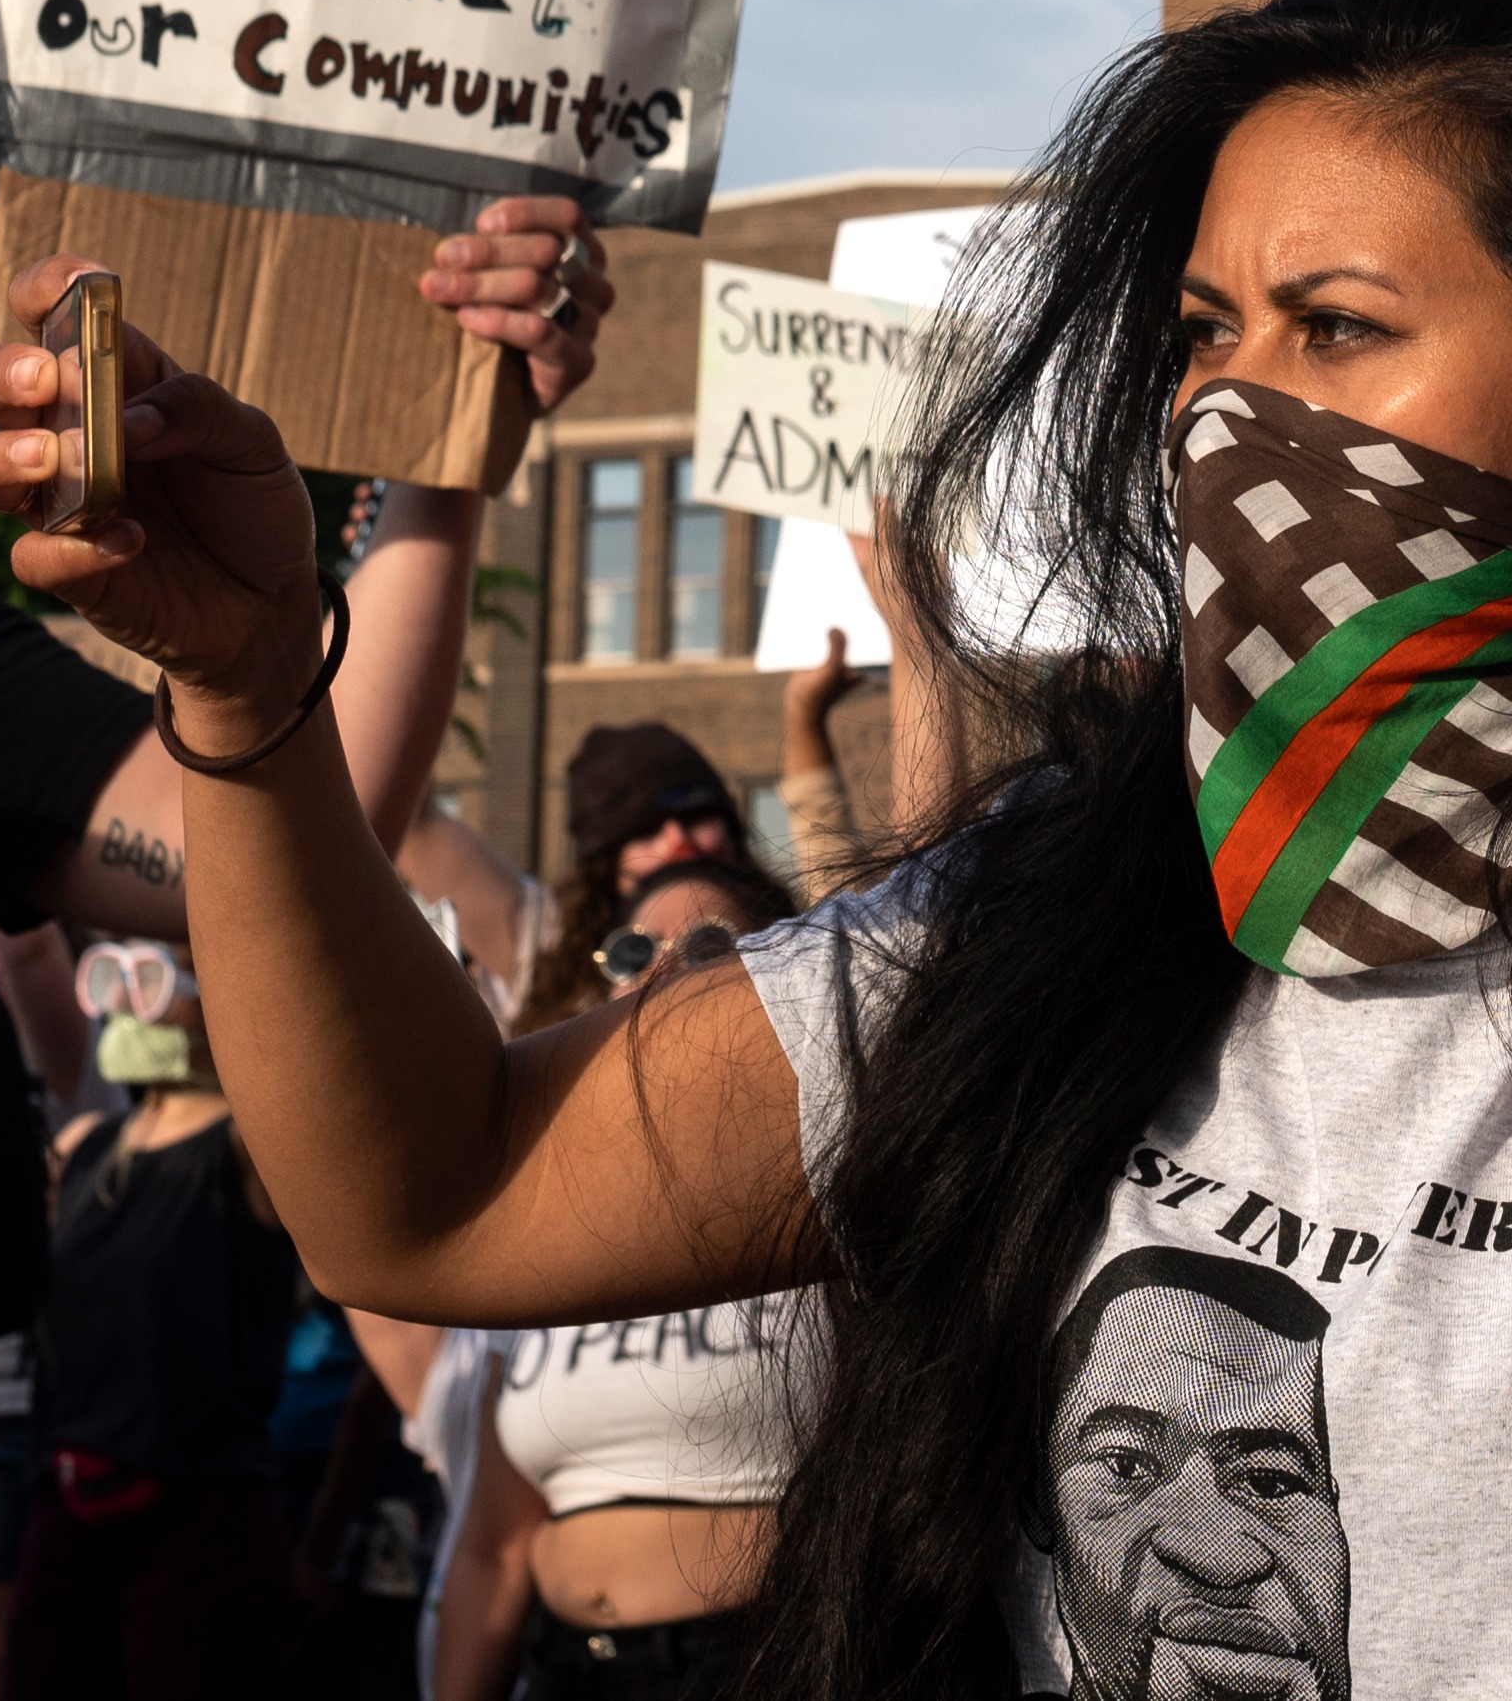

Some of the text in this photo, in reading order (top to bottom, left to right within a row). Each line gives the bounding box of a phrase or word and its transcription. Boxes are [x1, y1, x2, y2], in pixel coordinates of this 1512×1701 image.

[809, 364, 838, 418] &
[1125, 1147, 1228, 1210] ST
[1215, 1189, 1319, 1270] IN
